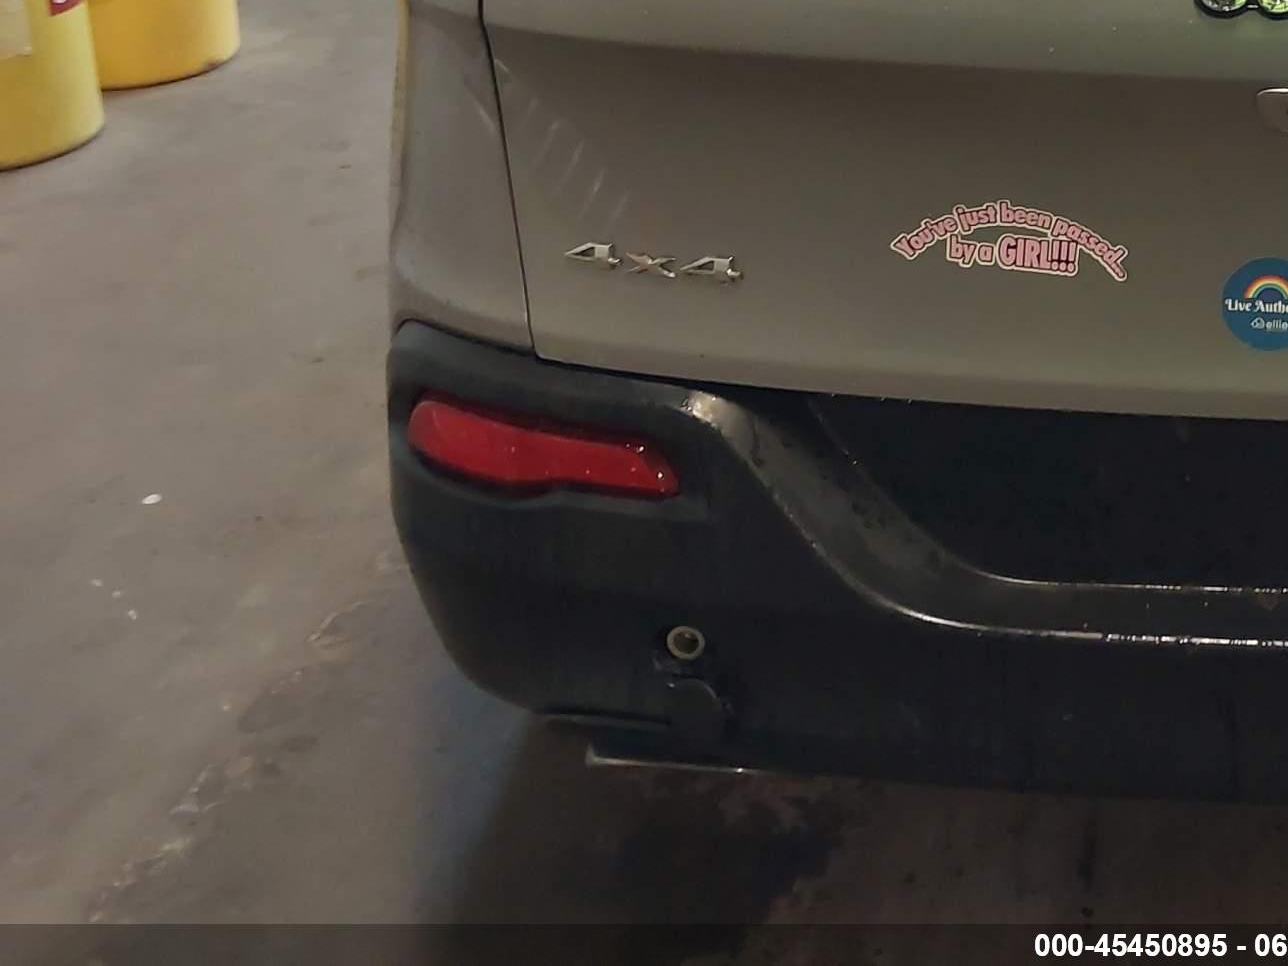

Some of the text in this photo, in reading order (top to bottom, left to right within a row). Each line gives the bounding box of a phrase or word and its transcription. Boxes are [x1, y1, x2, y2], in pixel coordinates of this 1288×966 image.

[895, 216, 958, 257] You've
[955, 206, 998, 232] just
[1000, 200, 1052, 230] been
[950, 235, 1078, 273] by a GIRL!!!
[1224, 298, 1252, 312] Live
